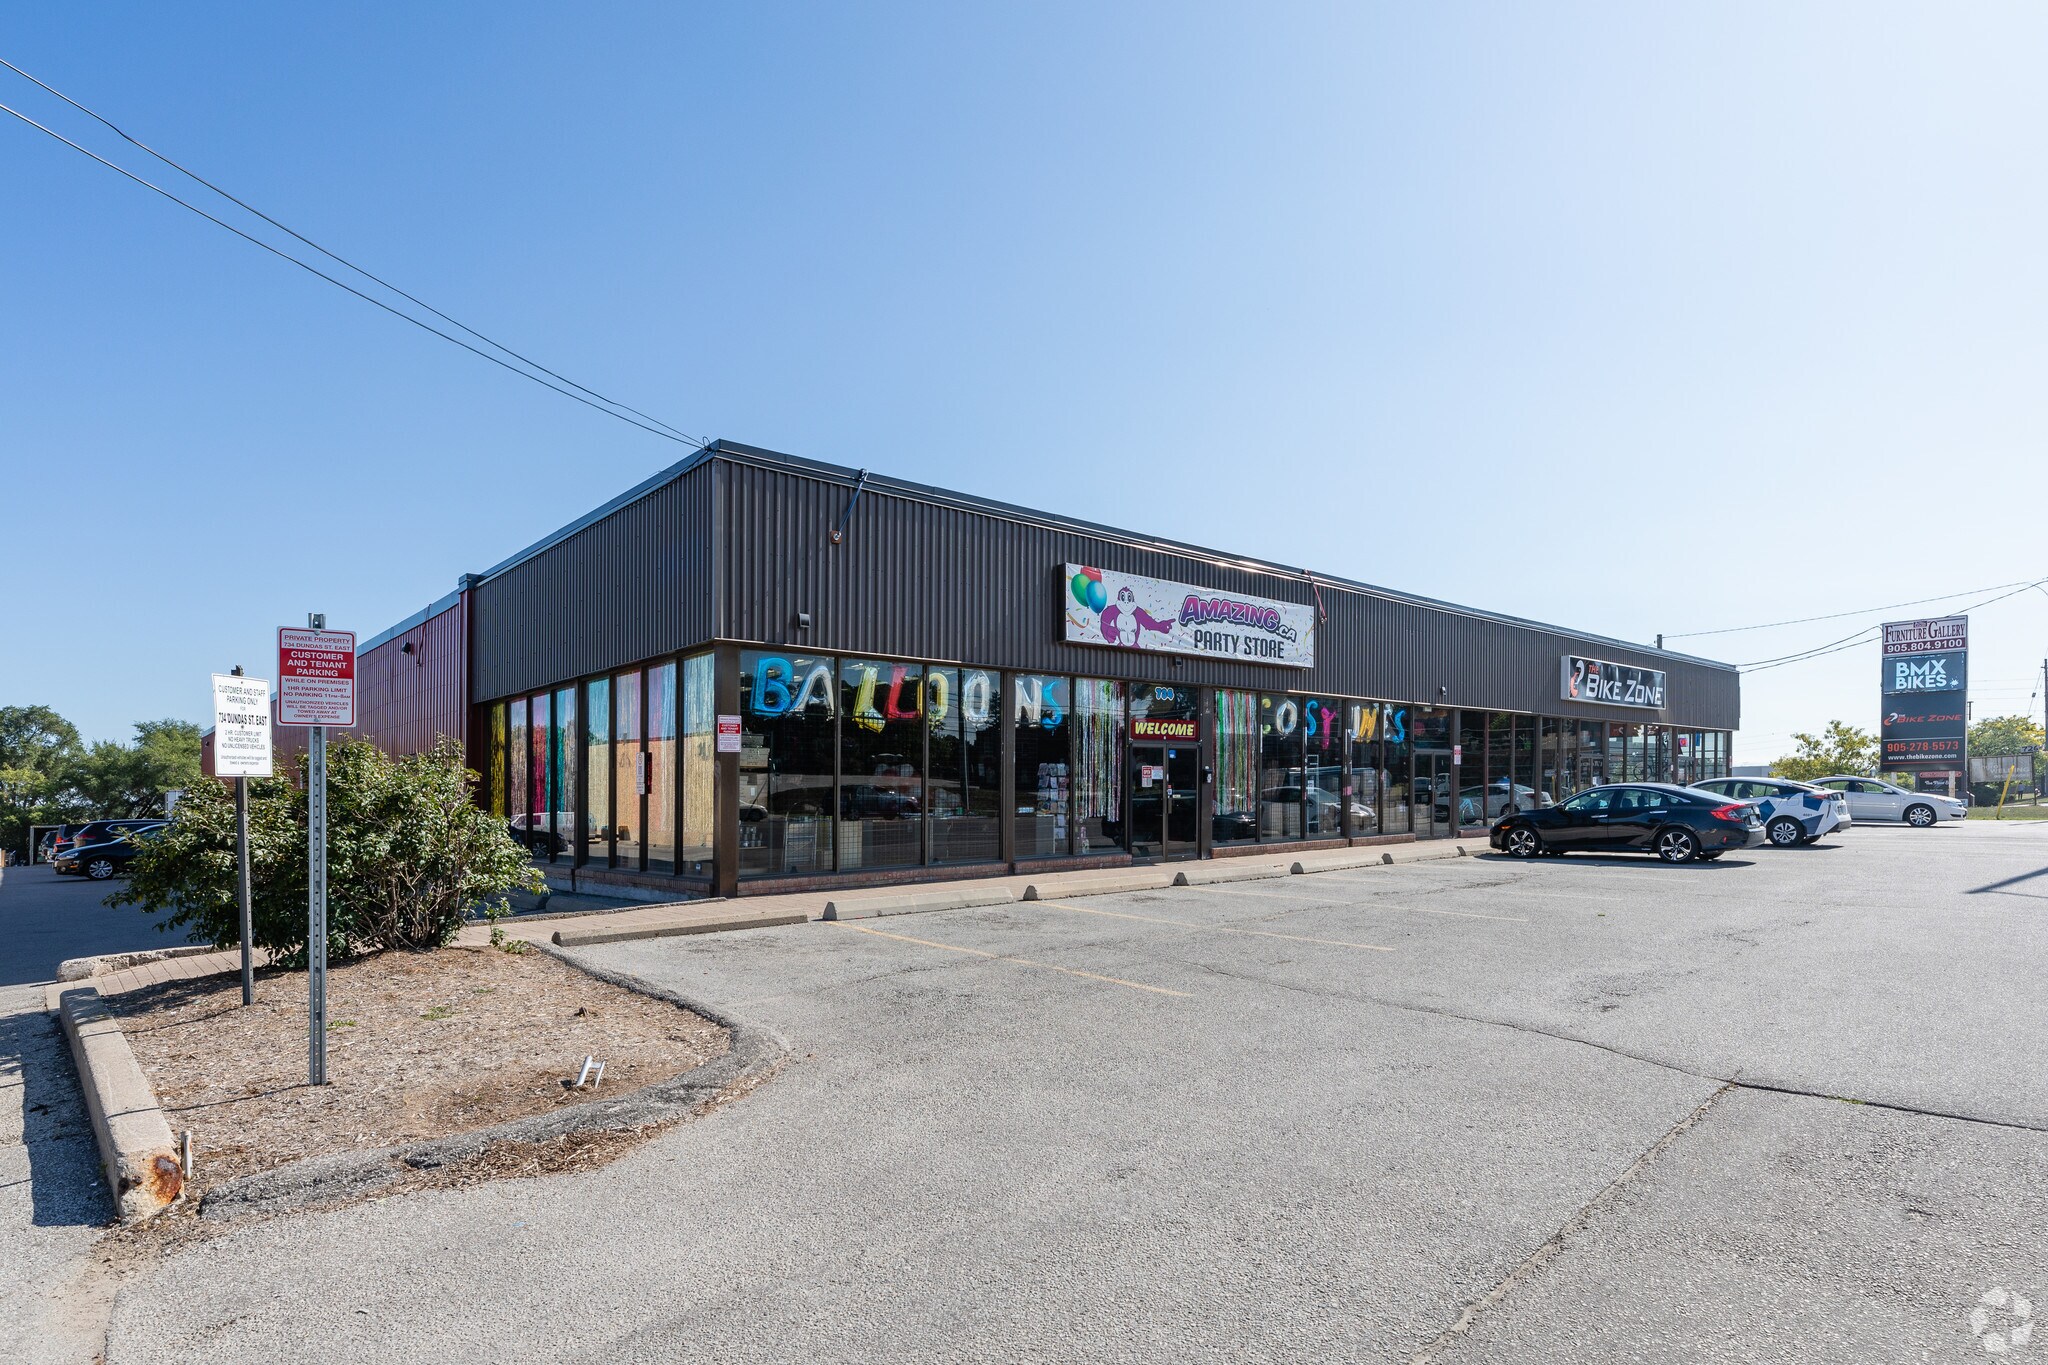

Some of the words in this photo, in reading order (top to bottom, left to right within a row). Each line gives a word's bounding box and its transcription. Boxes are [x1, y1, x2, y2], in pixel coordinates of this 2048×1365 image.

[1885, 626, 1927, 643] FURNITURE
[1928, 621, 1965, 639] GALLERY
[314, 636, 350, 644] PROPERTY
[1194, 629, 1240, 654] PARTY
[1244, 636, 1284, 658] STORE
[1887, 639, 1963, 653] 905.804.9100
[291, 651, 344, 660] CUSTOMER
[287, 659, 308, 667] AND
[310, 660, 348, 669] TENANT
[1588, 664, 1599, 674] THE
[1896, 659, 1947, 677] BMX
[296, 668, 339, 677] PARKING
[1586, 673, 1622, 701] BIKE
[1624, 680, 1664, 705] ZONE
[1895, 674, 1947, 690] BIKES
[218, 685, 242, 695] CUSTOMER
[243, 688, 253, 696] AND
[254, 689, 266, 697] STAFF
[750, 657, 1063, 734] BALLOONS
[226, 695, 246, 704] PARKING
[247, 697, 258, 705] ONLY
[218, 712, 226, 723] 734
[227, 712, 247, 724] DUNDAS
[256, 715, 267, 726] EAST
[1897, 715, 1925, 723] BIKE
[1927, 714, 1963, 722] ZONE
[1135, 721, 1195, 736] WELCOME
